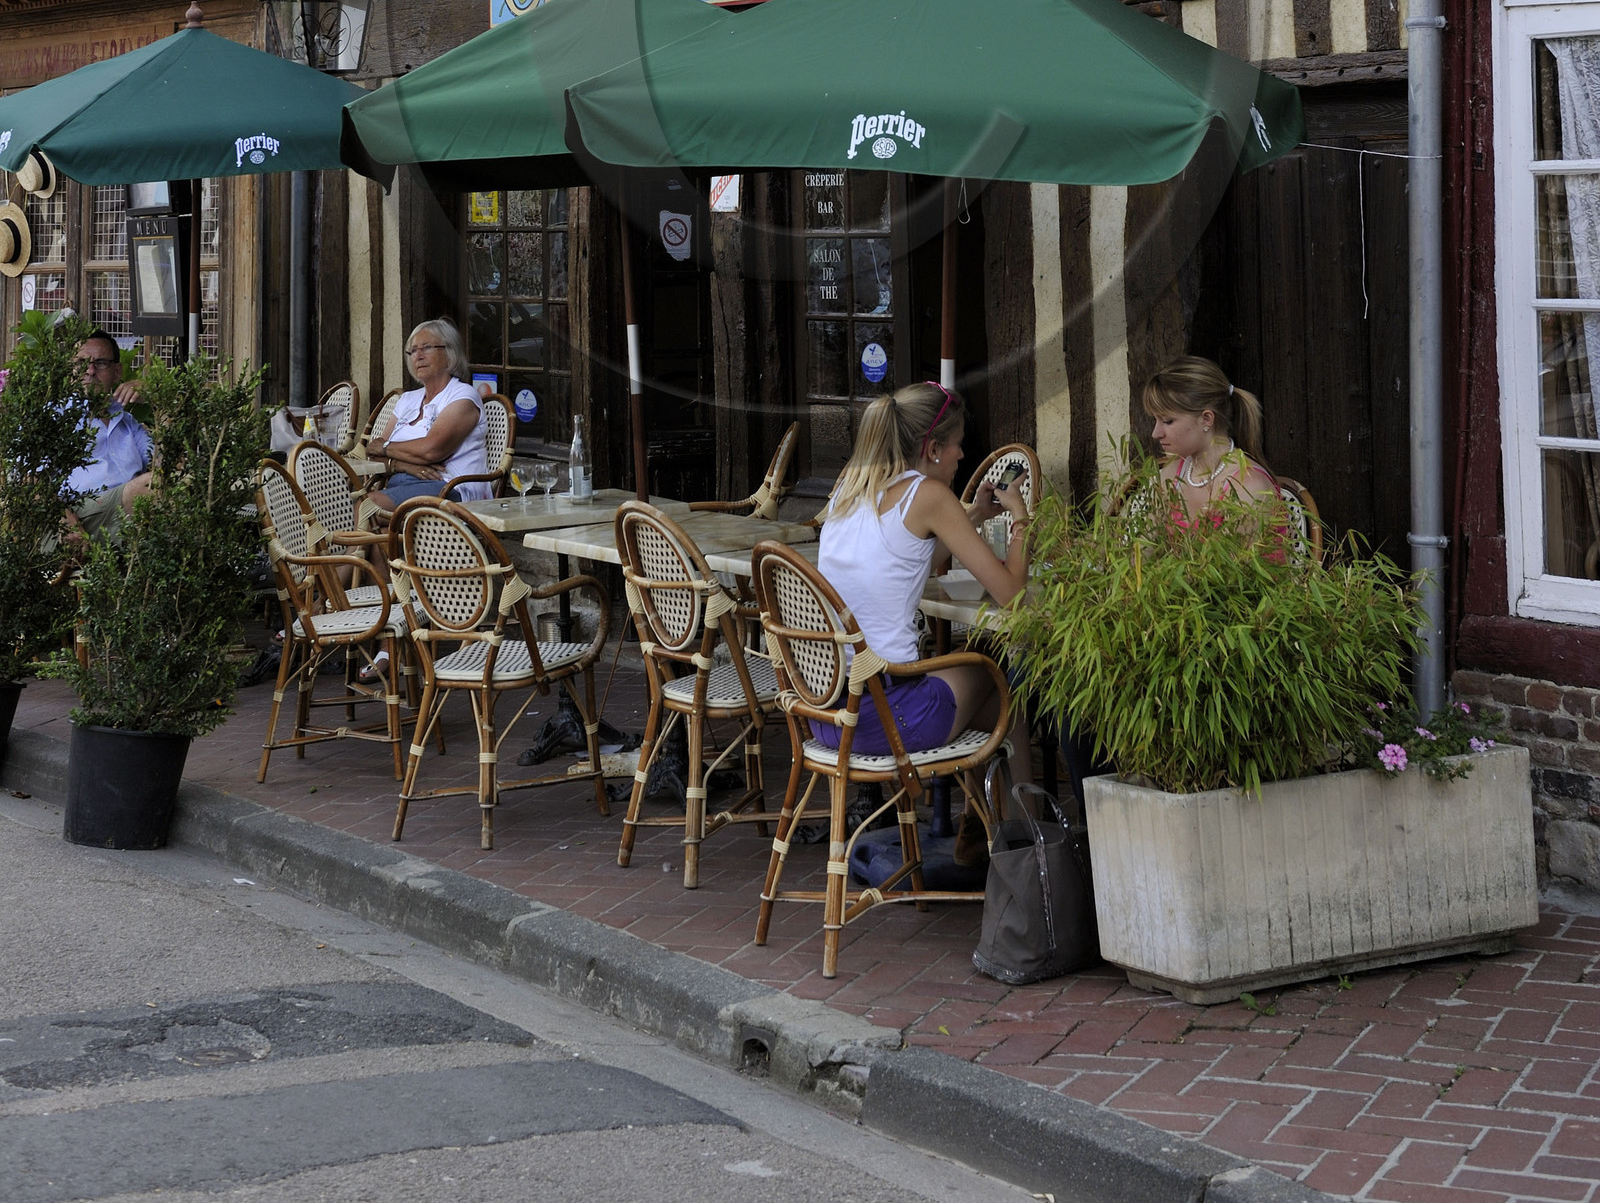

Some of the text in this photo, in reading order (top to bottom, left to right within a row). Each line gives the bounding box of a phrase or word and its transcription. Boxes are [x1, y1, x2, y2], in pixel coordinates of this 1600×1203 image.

[817, 201, 834, 214] BAR
[136, 219, 168, 236] MENU
[813, 248, 842, 263] SALON
[822, 267, 835, 281] DE
[820, 282, 838, 300] THÉ
